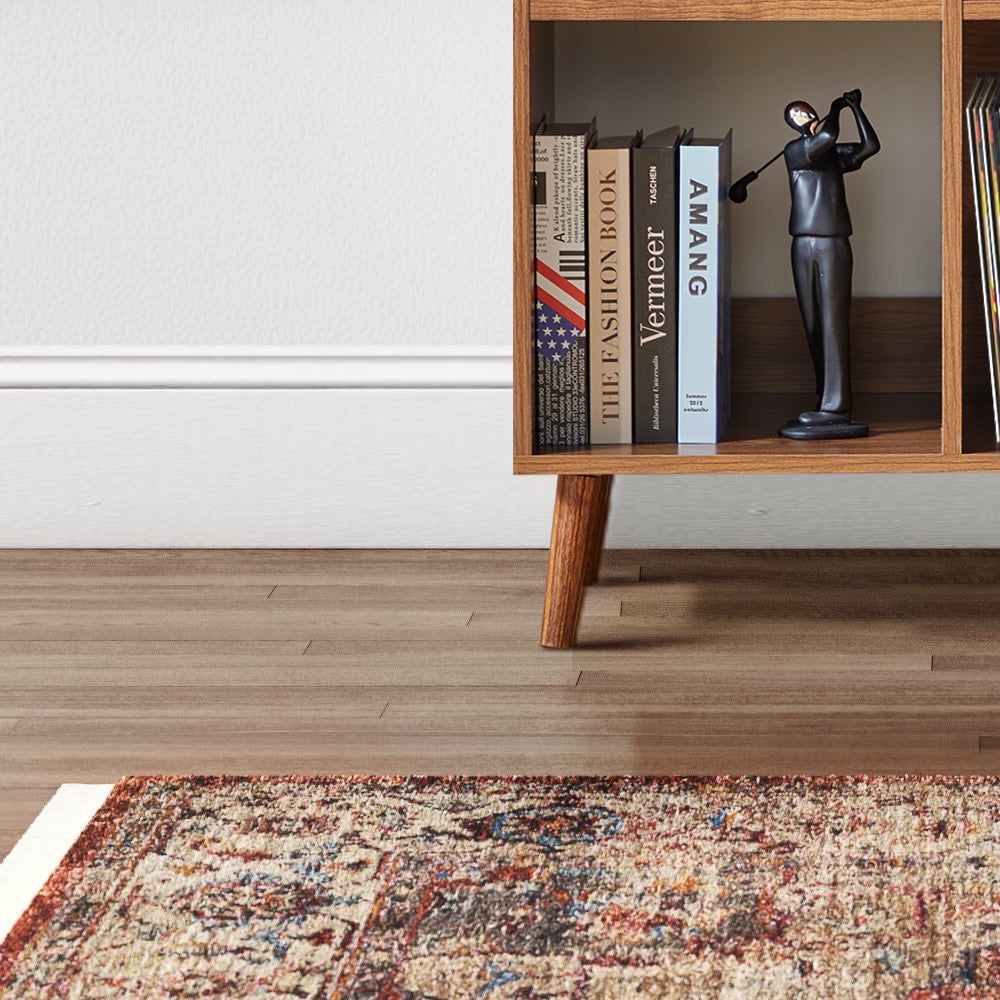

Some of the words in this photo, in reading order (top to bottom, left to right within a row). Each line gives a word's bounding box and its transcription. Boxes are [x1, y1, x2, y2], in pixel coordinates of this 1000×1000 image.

[599, 168, 617, 240] BOOK
[649, 165, 657, 204] TASCHEN
[553, 233, 565, 243] A
[688, 179, 709, 297] AMANG
[600, 248, 620, 363] FASHION
[640, 227, 667, 346] Vermeer
[601, 371, 620, 424] THE
